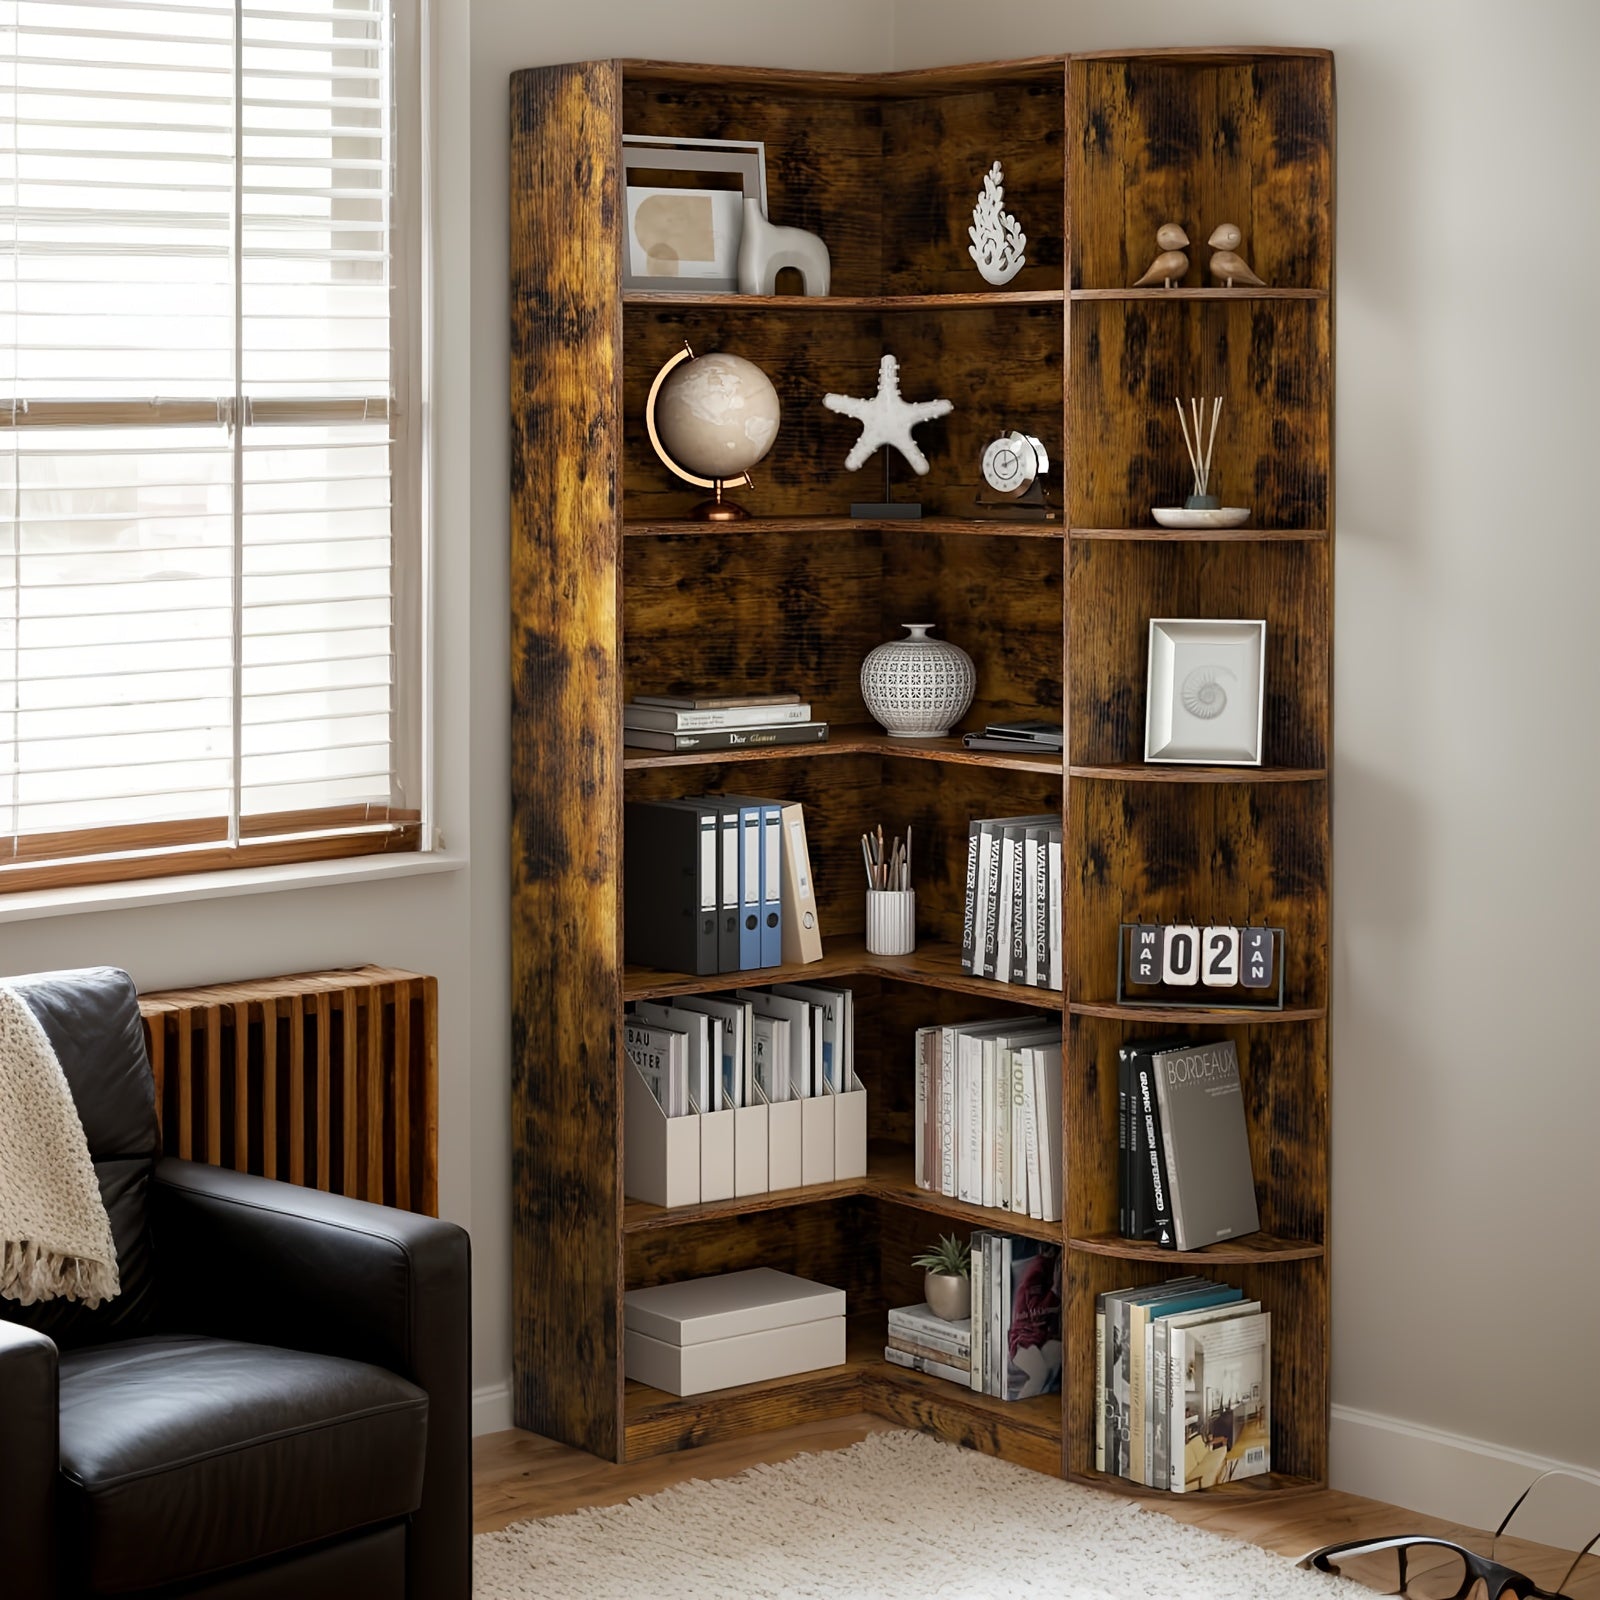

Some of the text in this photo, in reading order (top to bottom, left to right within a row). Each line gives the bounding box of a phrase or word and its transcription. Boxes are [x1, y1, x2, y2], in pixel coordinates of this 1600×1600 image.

[730, 733, 746, 744] Dior
[965, 835, 978, 889] WALTER
[989, 839, 1001, 894] WALTER
[1013, 842, 1023, 897] WALTER
[1037, 844, 1046, 900] WALTER
[962, 890, 975, 950] FINANCE
[985, 894, 997, 954] FINANCE
[1013, 898, 1023, 959] FINANCE
[1037, 901, 1046, 963] FINANCE
[1140, 932, 1155, 976] MAR
[1251, 935, 1264, 979] JAN
[628, 1029, 650, 1047] BAU
[1139, 1071, 1152, 1113] GRAPHIC
[1167, 1046, 1236, 1085] BORDEAUX
[1145, 1114, 1157, 1150] DESIGN
[1150, 1150, 1165, 1212] REFERENCED
